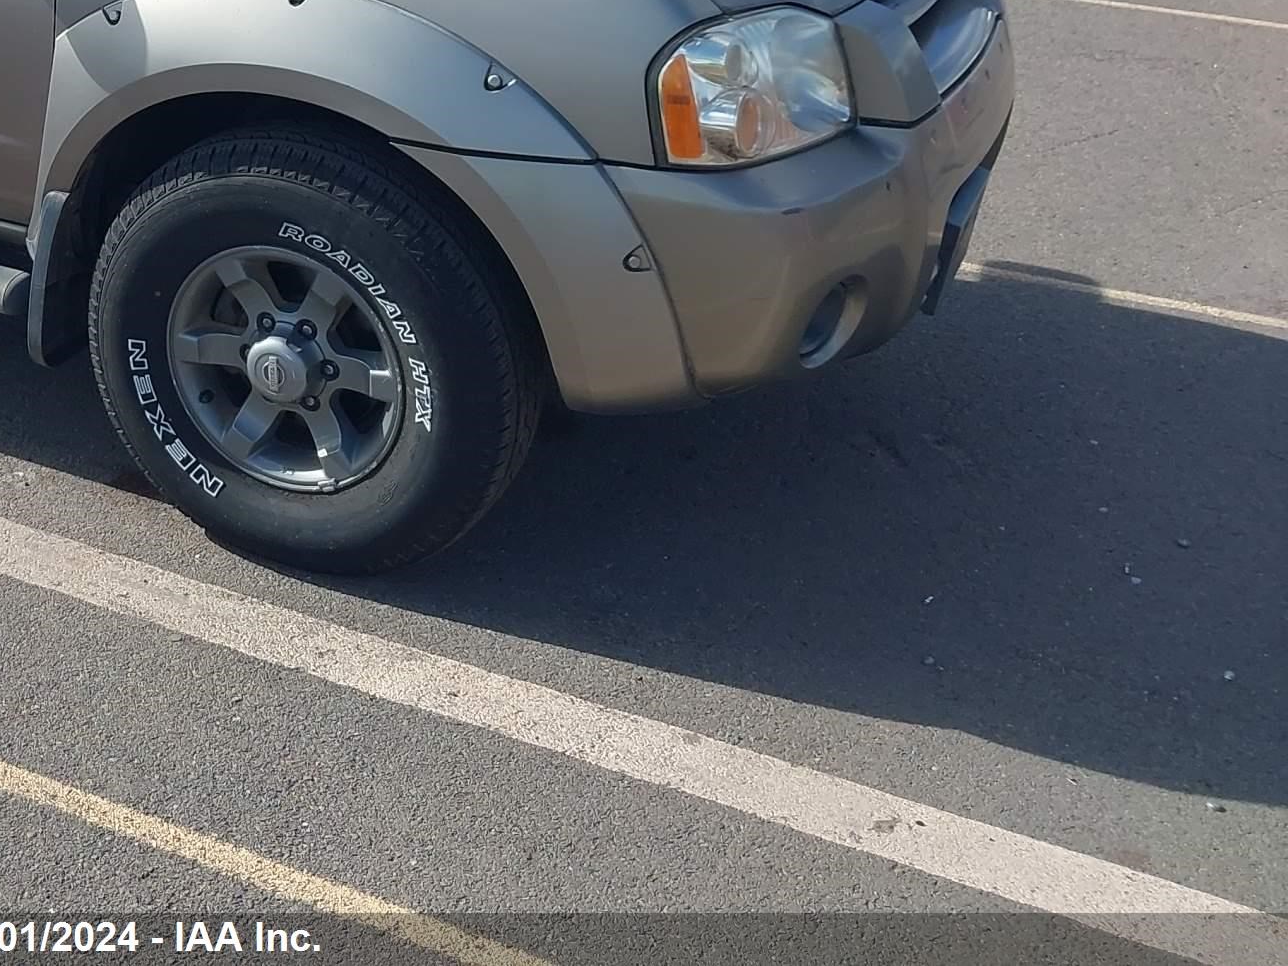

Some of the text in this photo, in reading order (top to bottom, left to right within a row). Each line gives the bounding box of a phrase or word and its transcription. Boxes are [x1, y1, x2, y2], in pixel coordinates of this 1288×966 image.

[128, 338, 224, 498] NEXEN
[278, 222, 433, 433] ROADIAN HTX
